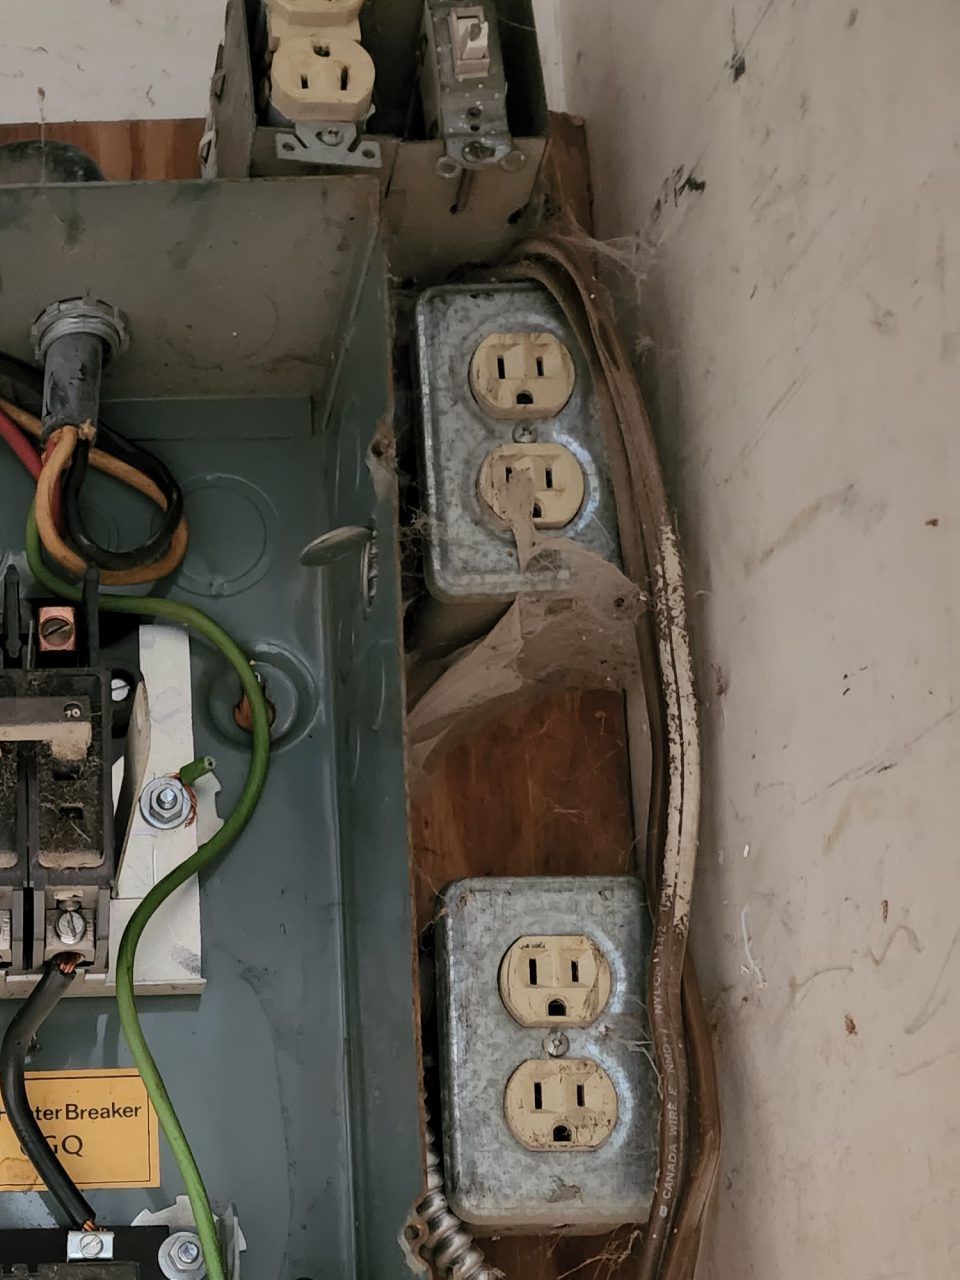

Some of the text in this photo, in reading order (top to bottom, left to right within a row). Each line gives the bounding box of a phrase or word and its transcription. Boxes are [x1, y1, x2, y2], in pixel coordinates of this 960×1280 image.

[65, 1102, 142, 1120] Breaker
[668, 1101, 678, 1136] WIRE
[662, 1144, 678, 1199] CANADA
